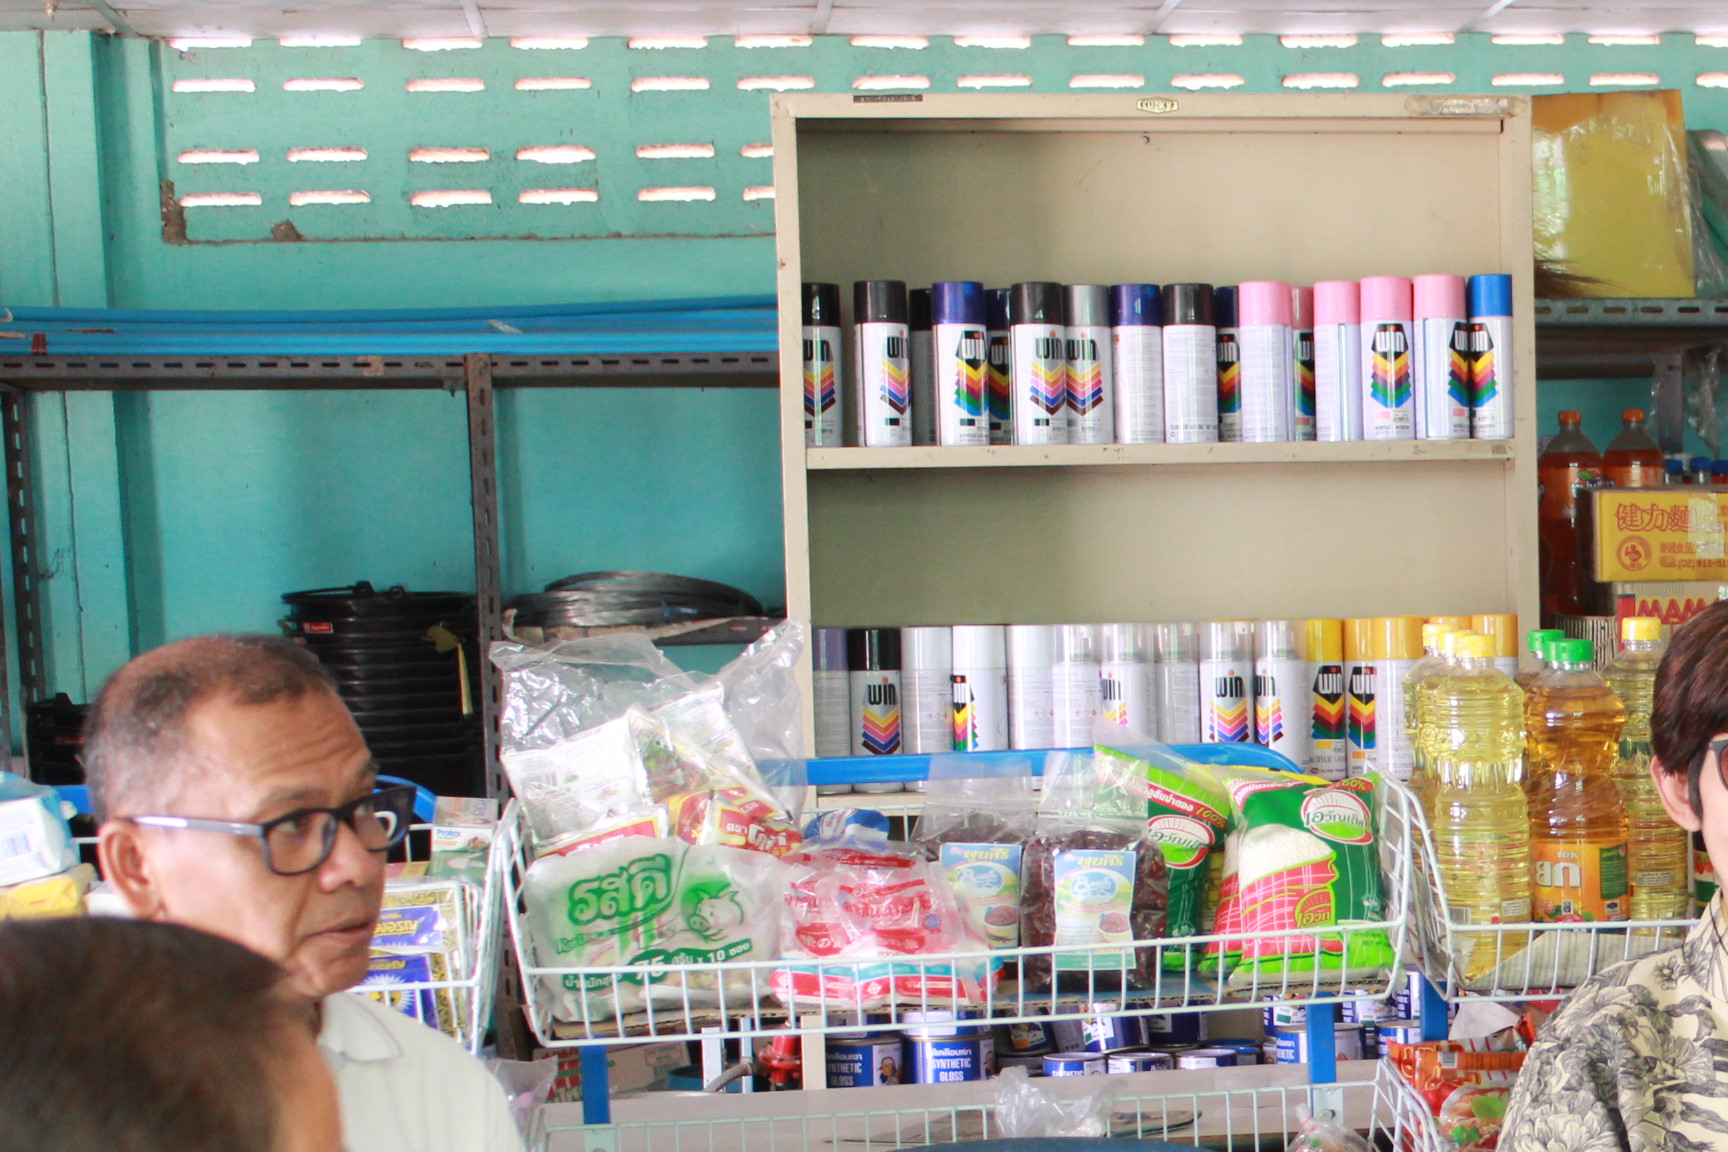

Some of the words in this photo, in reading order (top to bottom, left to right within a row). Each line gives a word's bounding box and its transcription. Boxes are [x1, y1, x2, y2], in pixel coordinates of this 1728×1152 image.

[826, 1061, 863, 1075] YNTHETIC
[931, 1057, 972, 1071] SYNTHETIC
[939, 1070, 964, 1083] GLOSS
